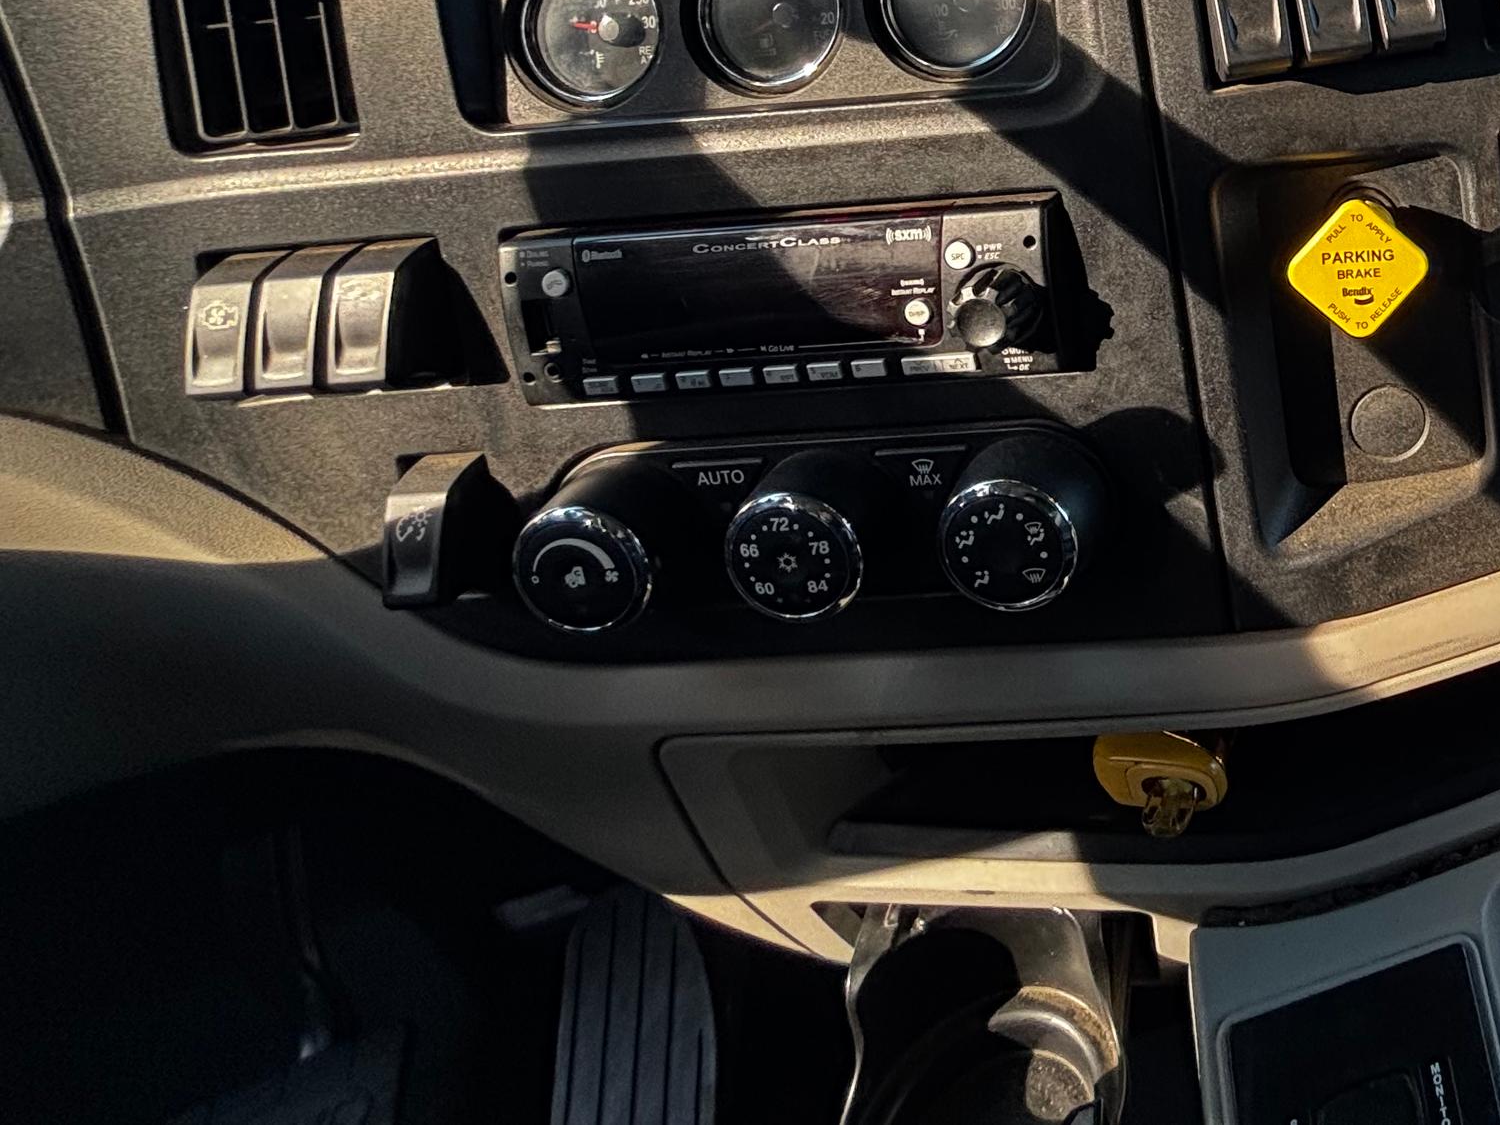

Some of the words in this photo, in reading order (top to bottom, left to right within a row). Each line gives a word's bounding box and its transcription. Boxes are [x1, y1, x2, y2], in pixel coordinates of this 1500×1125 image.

[1326, 225, 1346, 244] PULL
[1350, 214, 1364, 222] TO
[1366, 222, 1392, 244] APPLY
[984, 243, 1002, 252] PWR
[1321, 249, 1395, 265] PARKING
[1337, 268, 1382, 280] BRAKE
[1342, 286, 1372, 297] Bendix
[1327, 303, 1351, 324] PUSH
[1355, 321, 1369, 330] TO
[1370, 287, 1403, 322] RELEASE
[698, 469, 745, 487] AUTO
[909, 474, 943, 487] MAX
[769, 518, 790, 532] 72
[739, 544, 760, 558] 66
[808, 541, 830, 555] 78
[754, 581, 776, 596] 60
[807, 580, 829, 594] 84
